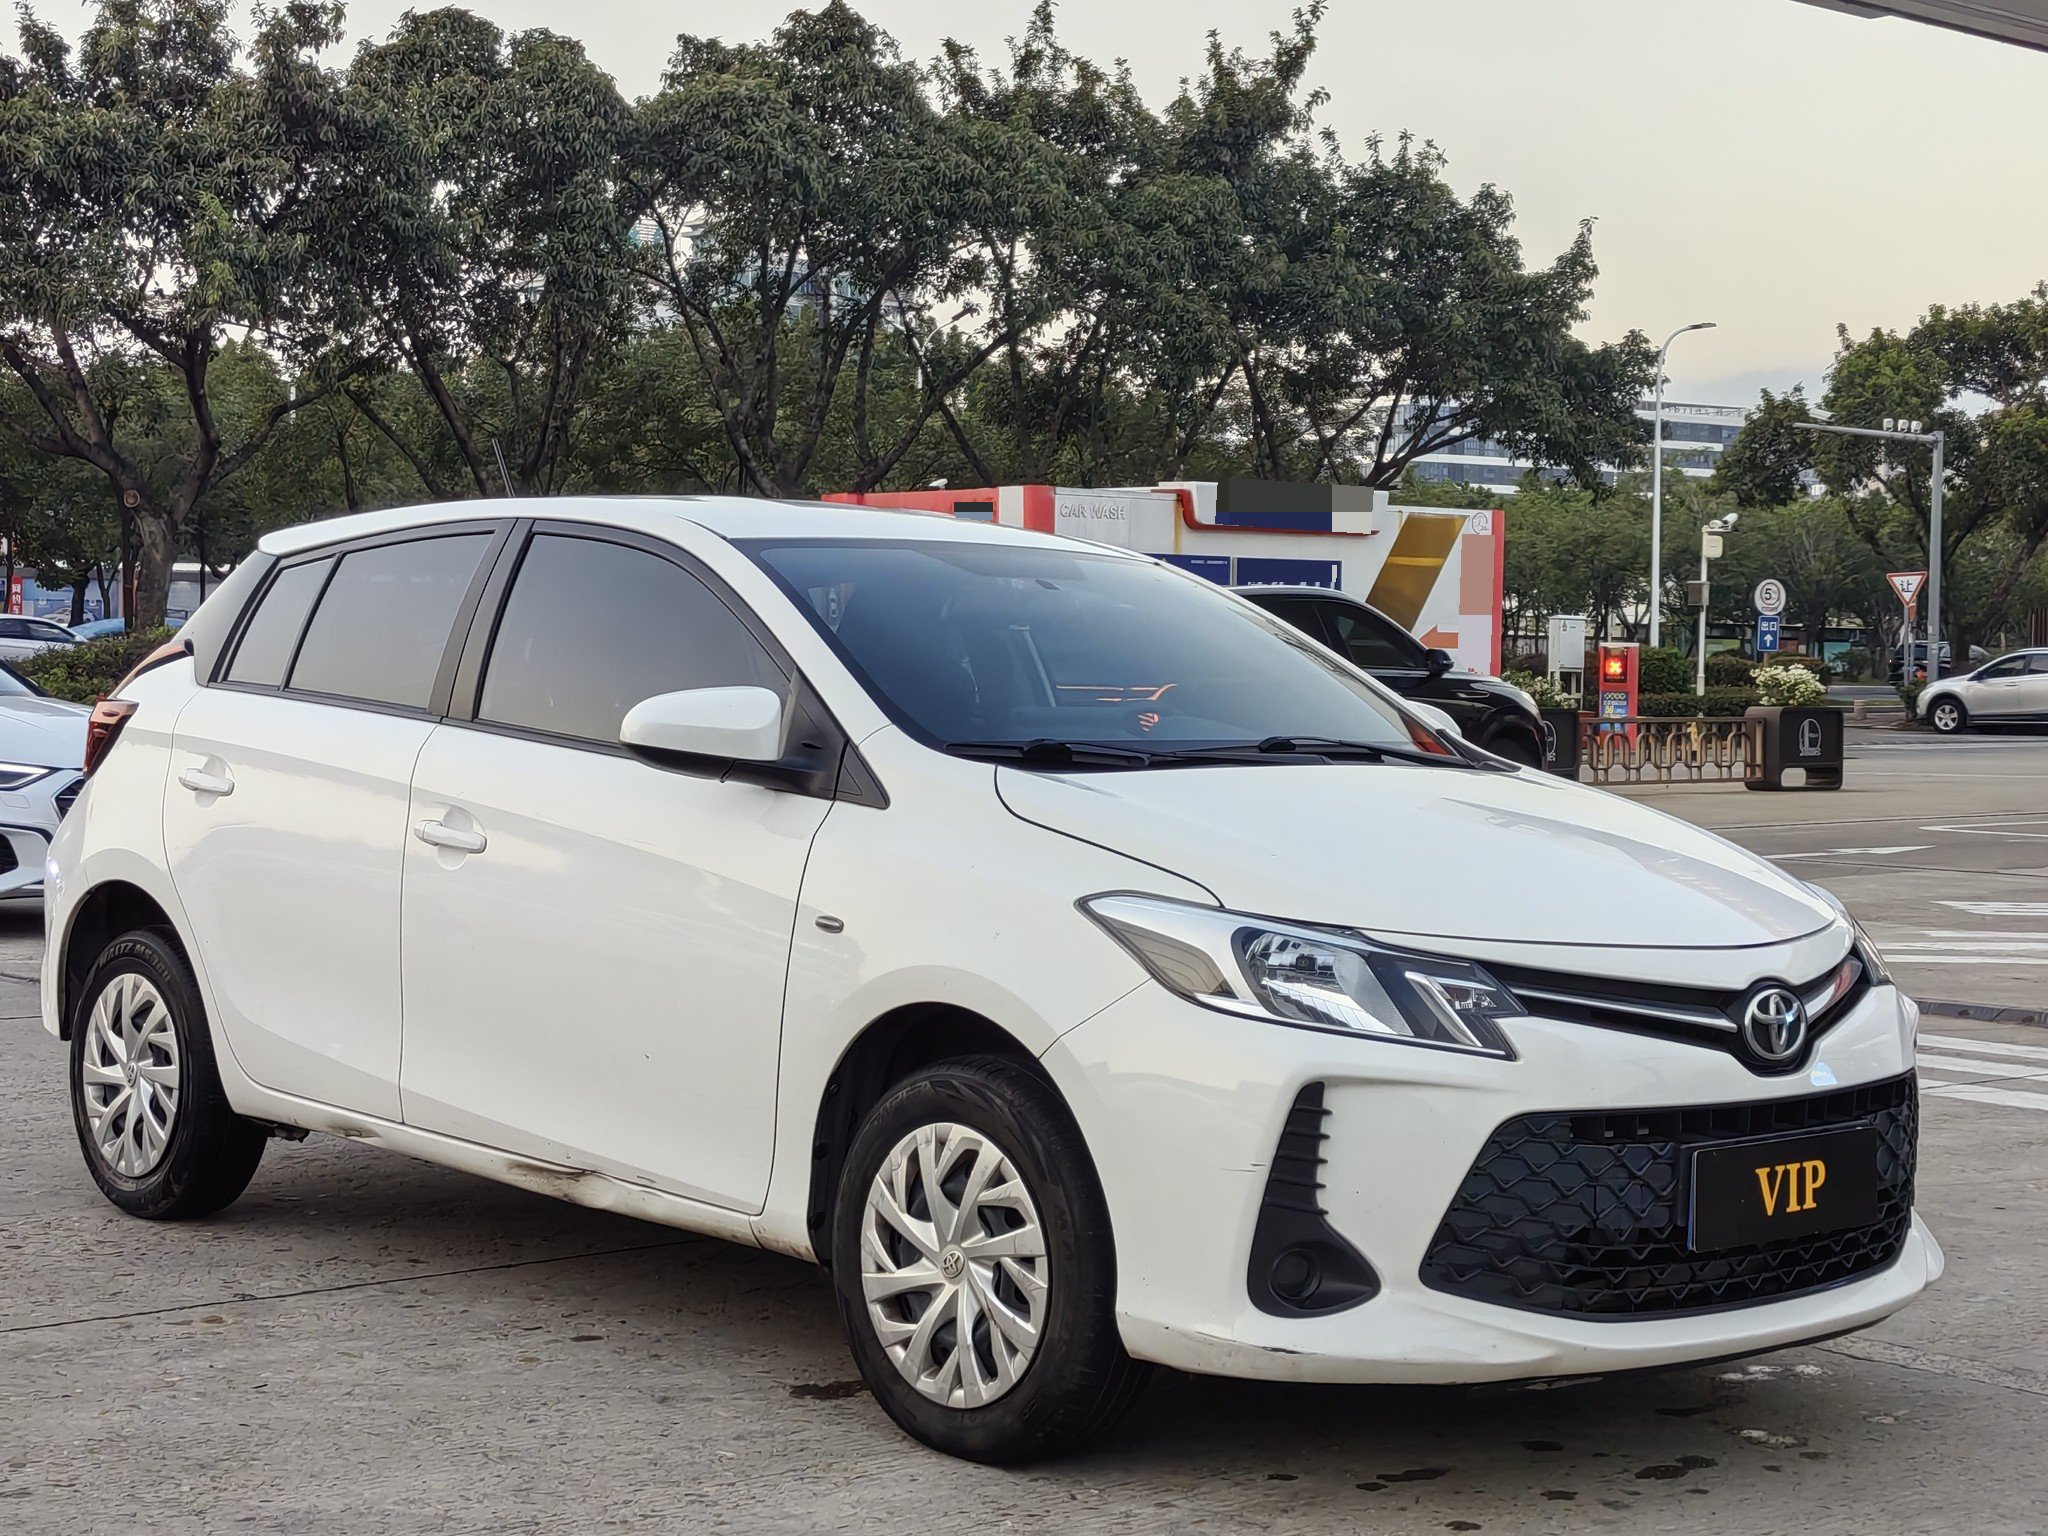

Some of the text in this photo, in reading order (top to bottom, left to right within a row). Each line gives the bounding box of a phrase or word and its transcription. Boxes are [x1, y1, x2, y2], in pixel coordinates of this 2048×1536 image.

[1060, 503, 1126, 520] CAR WASH
[1899, 579, 1914, 593] 让
[1764, 588, 1773, 600] 5
[1755, 1159, 1826, 1216] VIP
